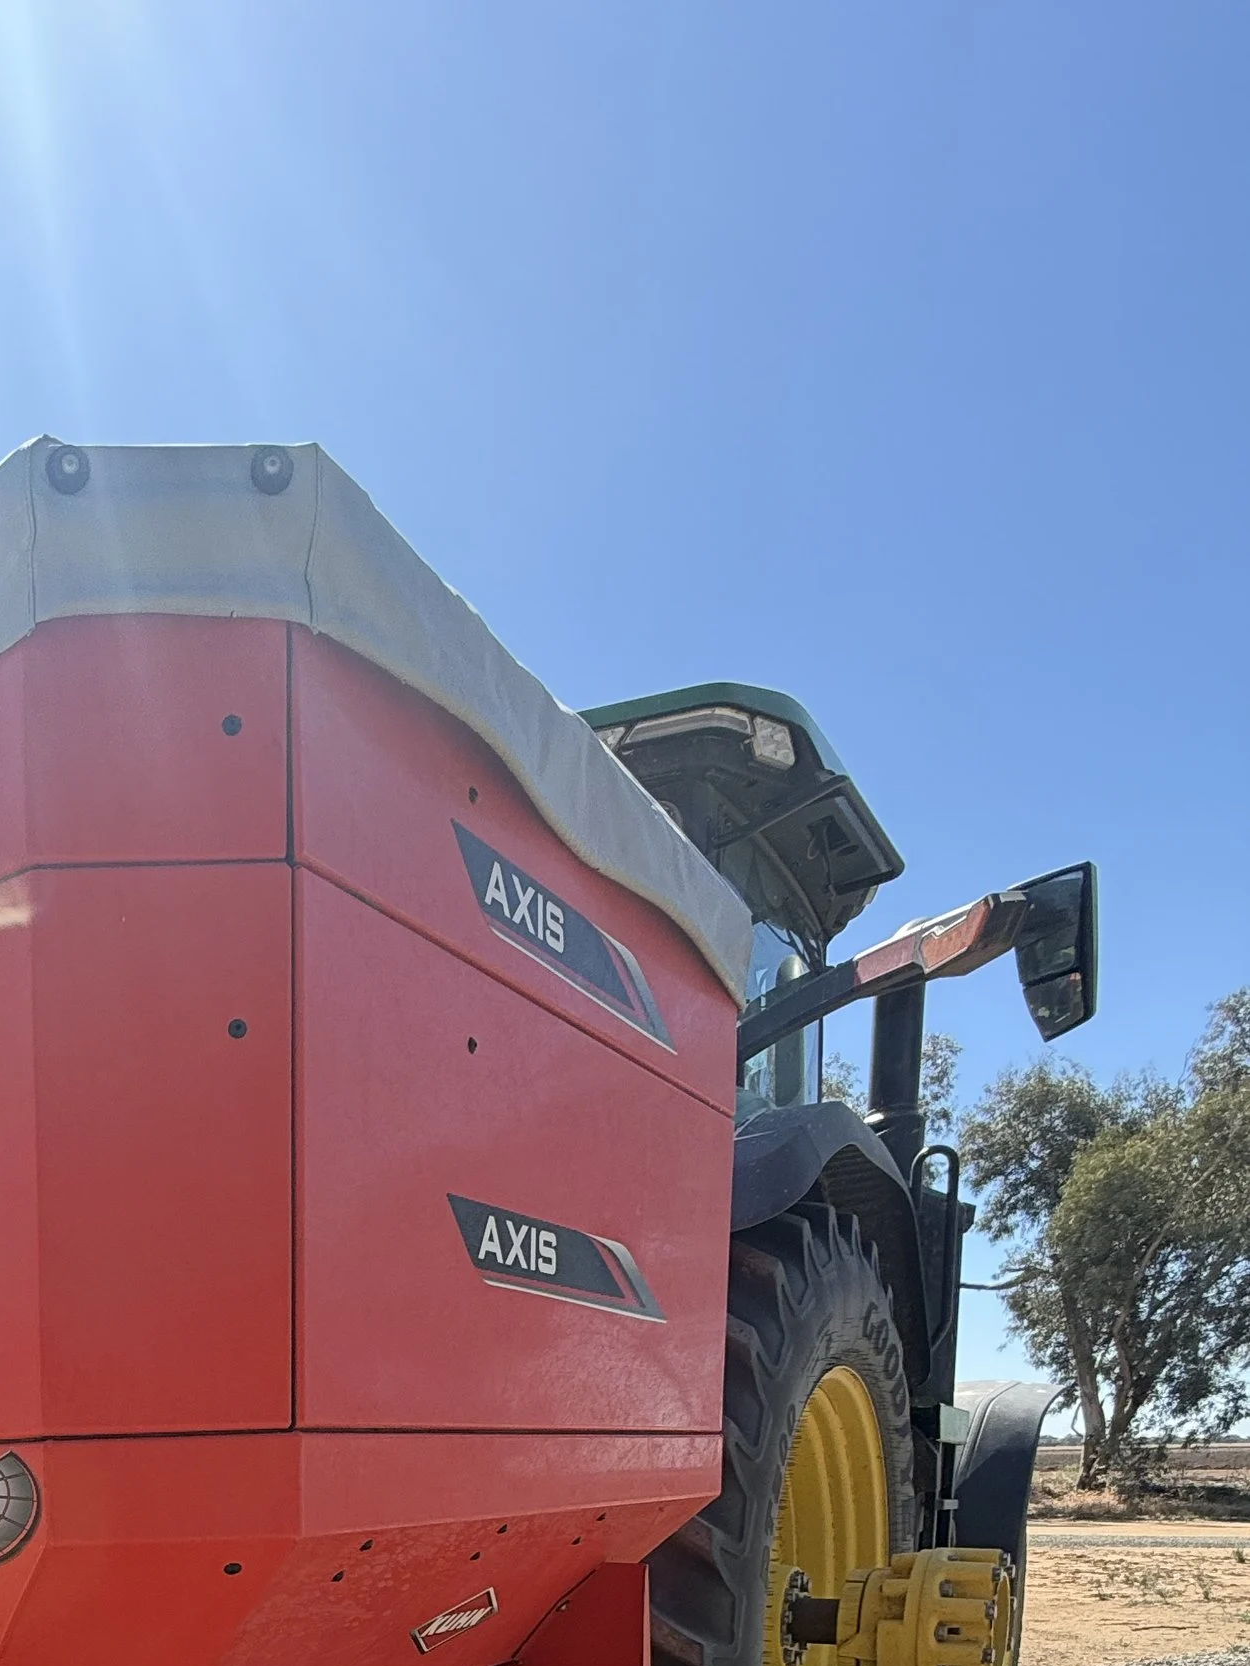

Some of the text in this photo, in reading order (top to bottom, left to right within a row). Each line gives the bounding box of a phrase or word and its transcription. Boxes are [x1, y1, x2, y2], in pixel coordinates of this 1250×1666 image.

[484, 861, 565, 954] AXIS
[477, 1215, 557, 1275] AXIS
[420, 1606, 493, 1638] KUHN
